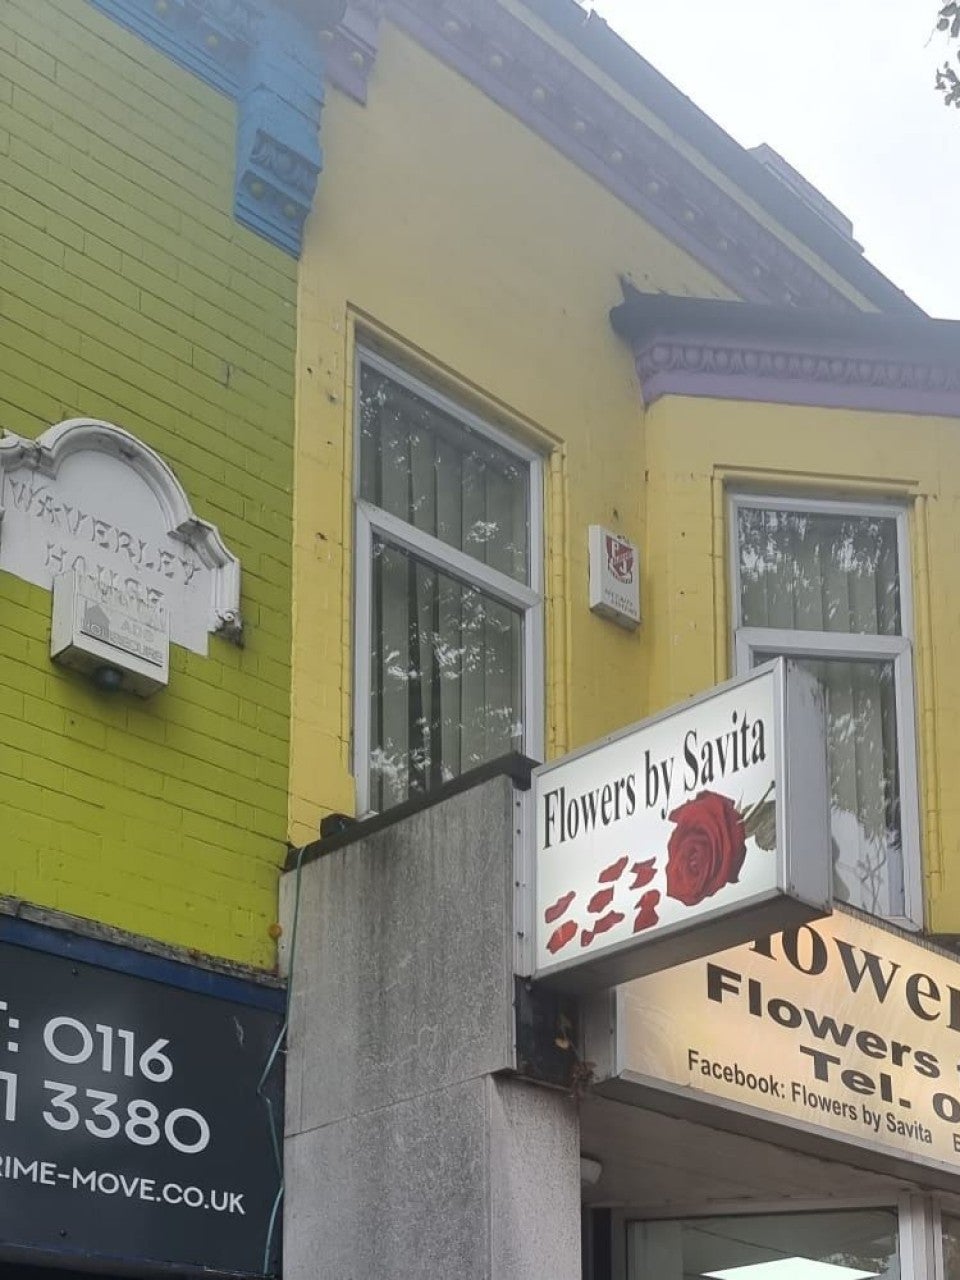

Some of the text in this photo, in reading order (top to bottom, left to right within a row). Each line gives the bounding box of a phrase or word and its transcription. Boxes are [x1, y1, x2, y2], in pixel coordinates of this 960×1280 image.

[8, 476, 201, 586] WAVERLEY
[542, 710, 767, 850] Flowers by Savita
[43, 1015, 174, 1083] 0116
[706, 962, 941, 1079] Flowers
[42, 1079, 211, 1154] 3380
[687, 1048, 786, 1099] Facebook:
[791, 1081, 859, 1121] Flowers
[861, 1108, 882, 1133] by
[885, 1113, 933, 1145] Savita
[799, 1044, 912, 1109] Tel.
[0, 1156, 246, 1216] IME-MOVE.CO.UK
